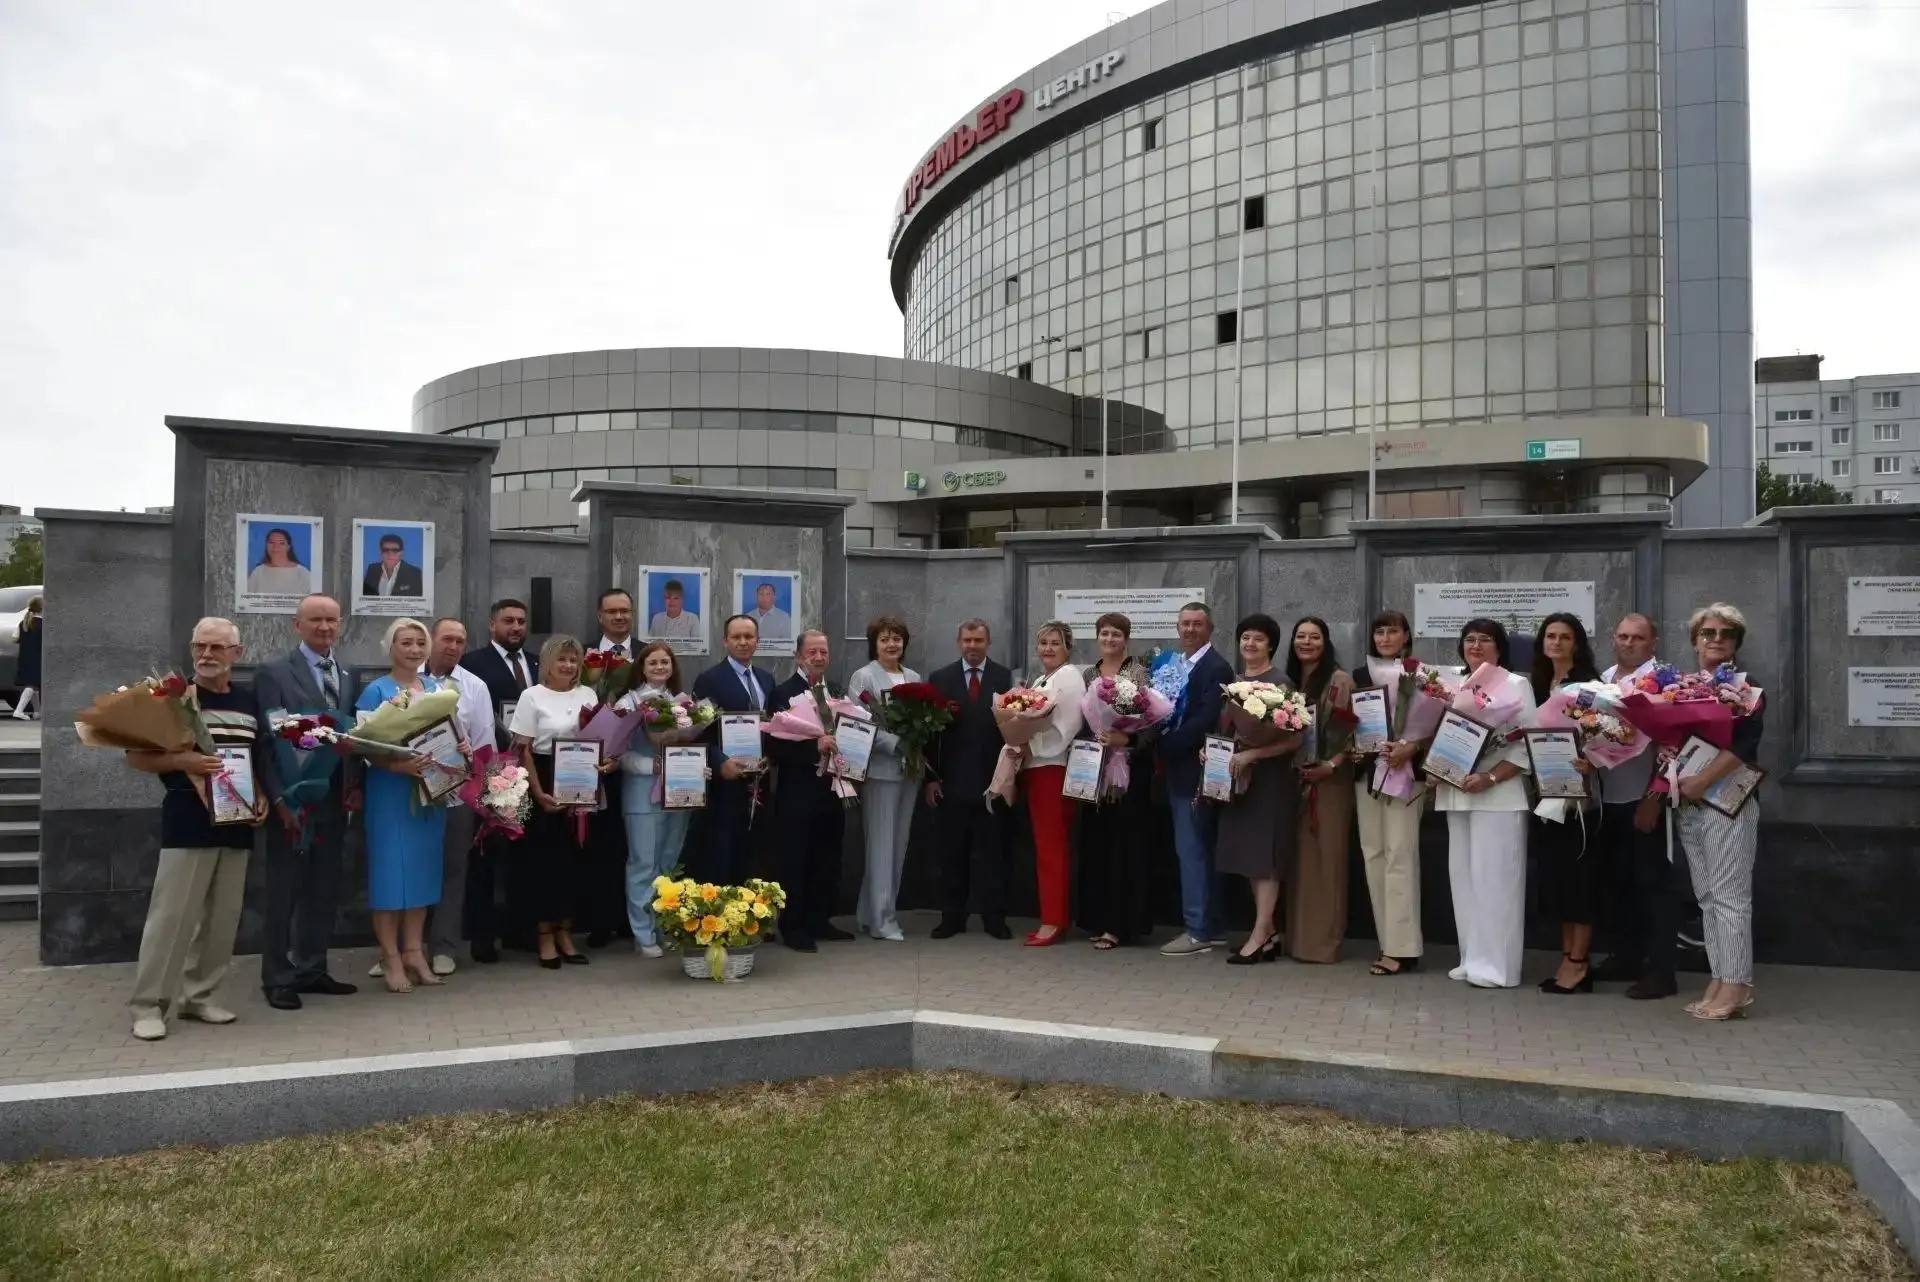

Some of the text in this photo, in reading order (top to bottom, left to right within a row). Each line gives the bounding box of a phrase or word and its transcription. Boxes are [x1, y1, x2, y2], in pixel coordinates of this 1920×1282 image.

[904, 49, 1126, 214] ПРЕМЬЕР ЦЕНТР
[962, 471, 1006, 487] СБЕР
